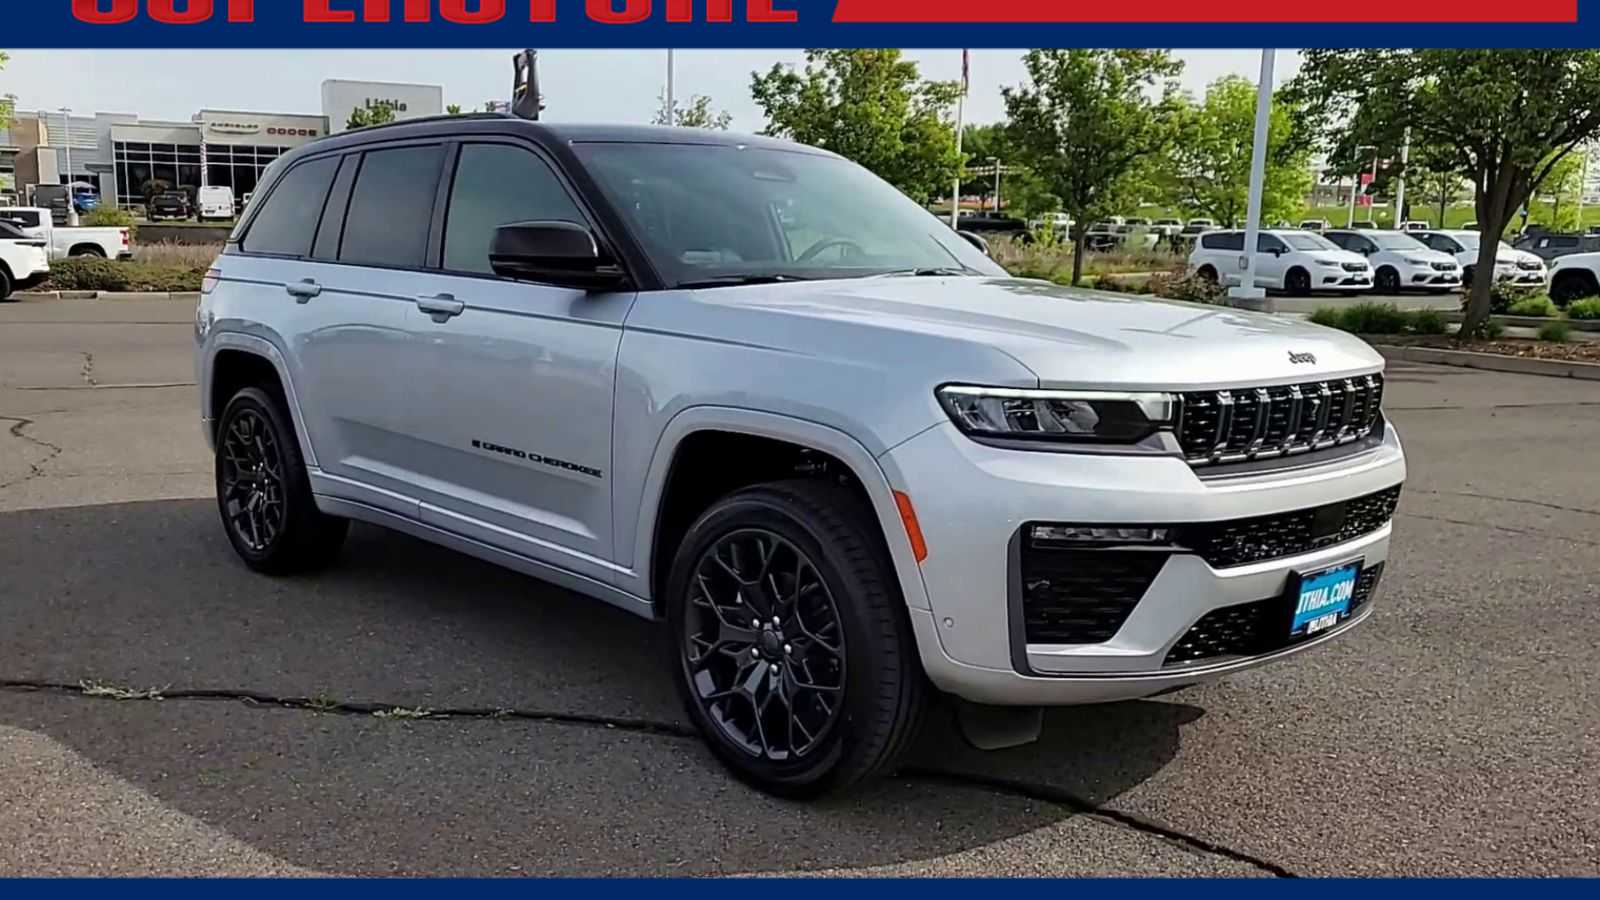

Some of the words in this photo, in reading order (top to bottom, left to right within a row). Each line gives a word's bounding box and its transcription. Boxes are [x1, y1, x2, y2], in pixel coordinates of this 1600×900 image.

[1288, 350, 1317, 365] Jeep
[482, 442, 526, 458] GRAND
[528, 453, 602, 478] CHEROKEE
